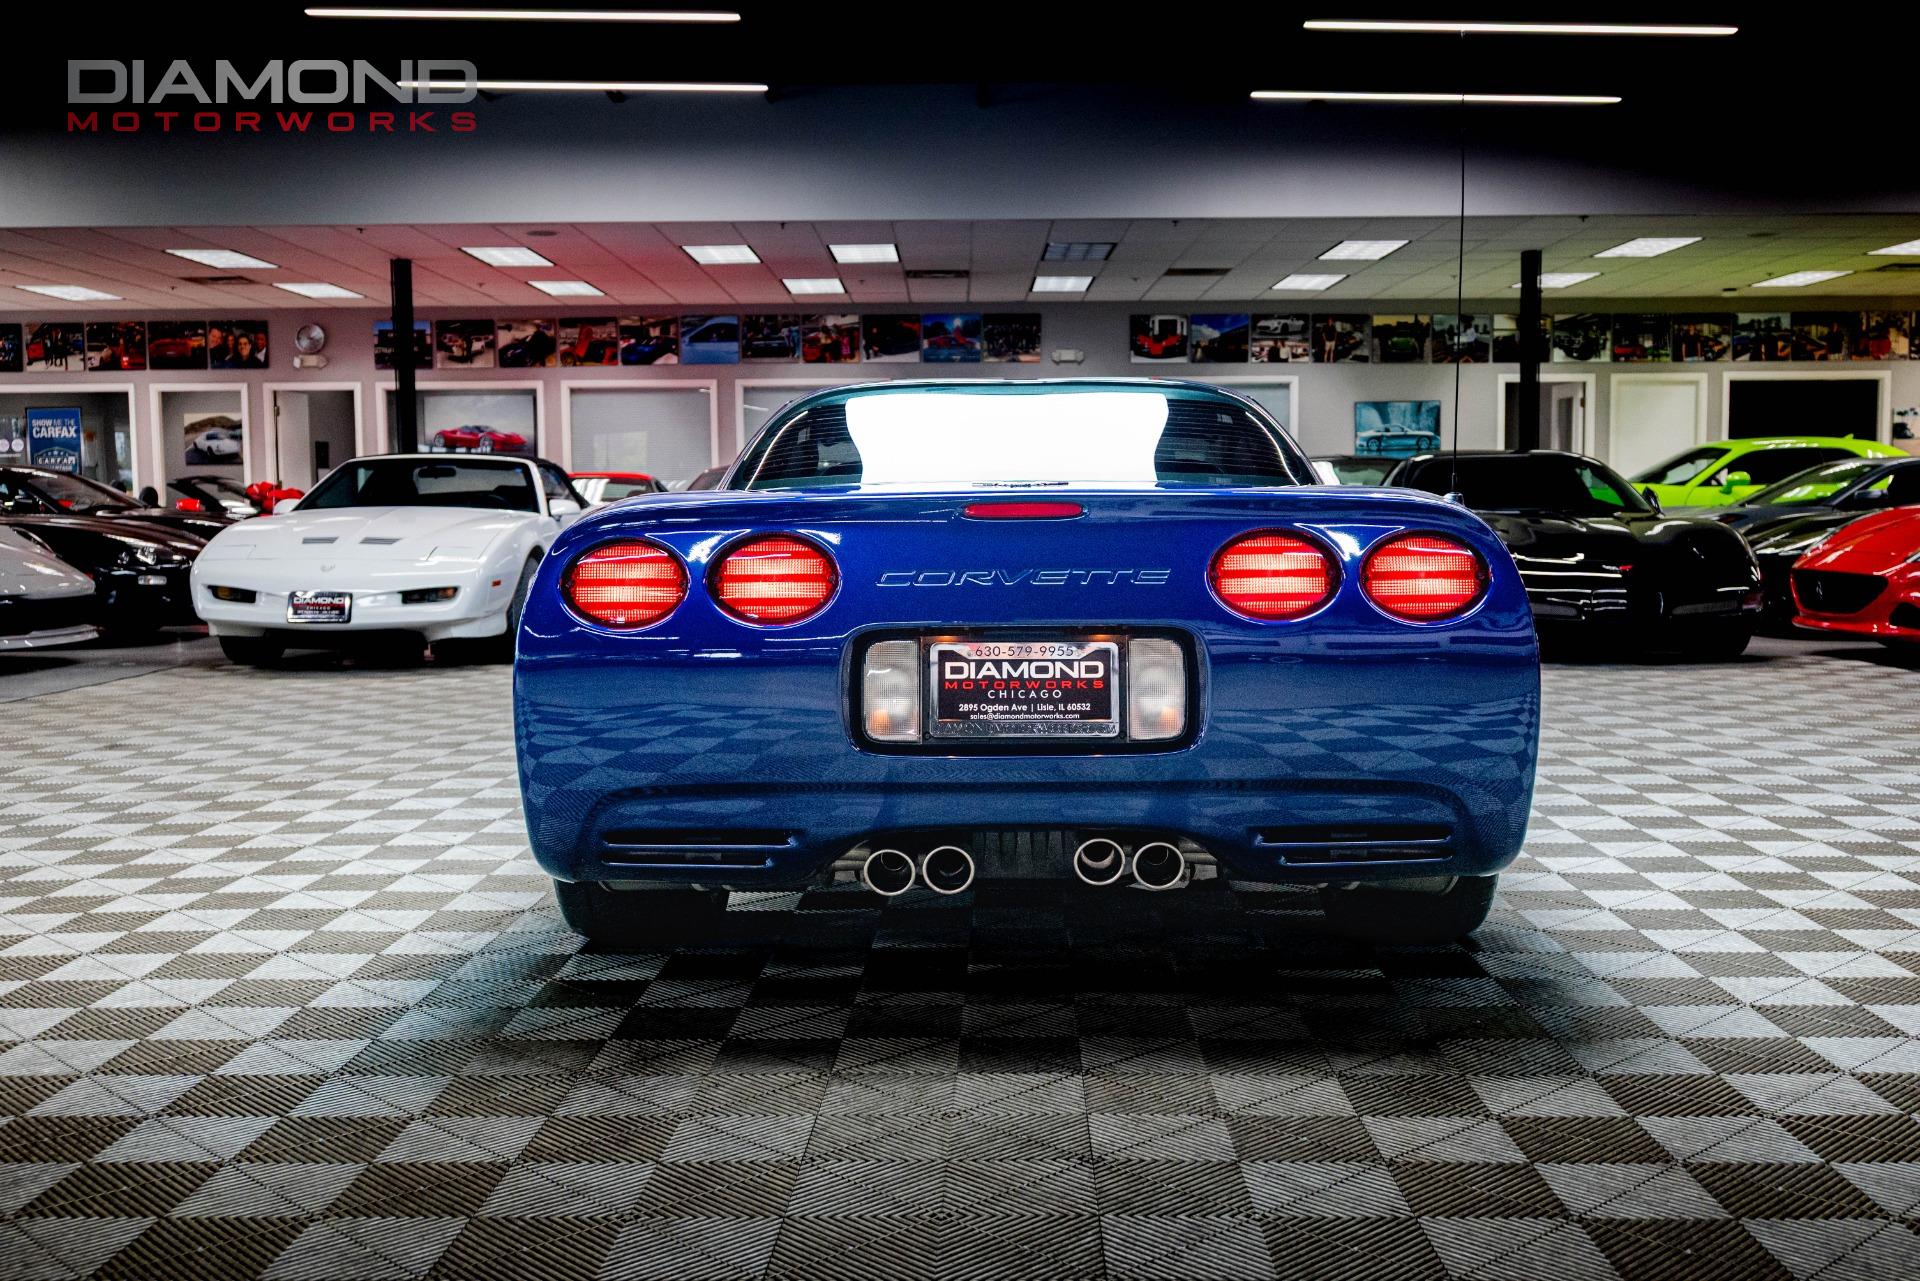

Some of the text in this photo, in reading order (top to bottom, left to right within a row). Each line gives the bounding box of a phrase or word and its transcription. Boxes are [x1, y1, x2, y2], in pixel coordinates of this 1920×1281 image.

[32, 418, 52, 427] SHOW
[32, 426, 77, 439] CARFAX
[875, 568, 1171, 587] CORVETTE
[975, 645, 1074, 657] 630-579-9955
[944, 661, 1104, 679] DIAMOND
[944, 680, 1104, 690] MOTORWORKS
[987, 689, 1062, 699] CHICAGO
[958, 703, 978, 712] 2895
[980, 703, 1009, 713] Ogden
[1011, 703, 1028, 712] Ave
[1037, 703, 1057, 712] Lisle,
[1058, 703, 1066, 711] IL
[1066, 702, 1091, 711] 60532
[970, 712, 1080, 721] sales@diamondmotorworks.com
